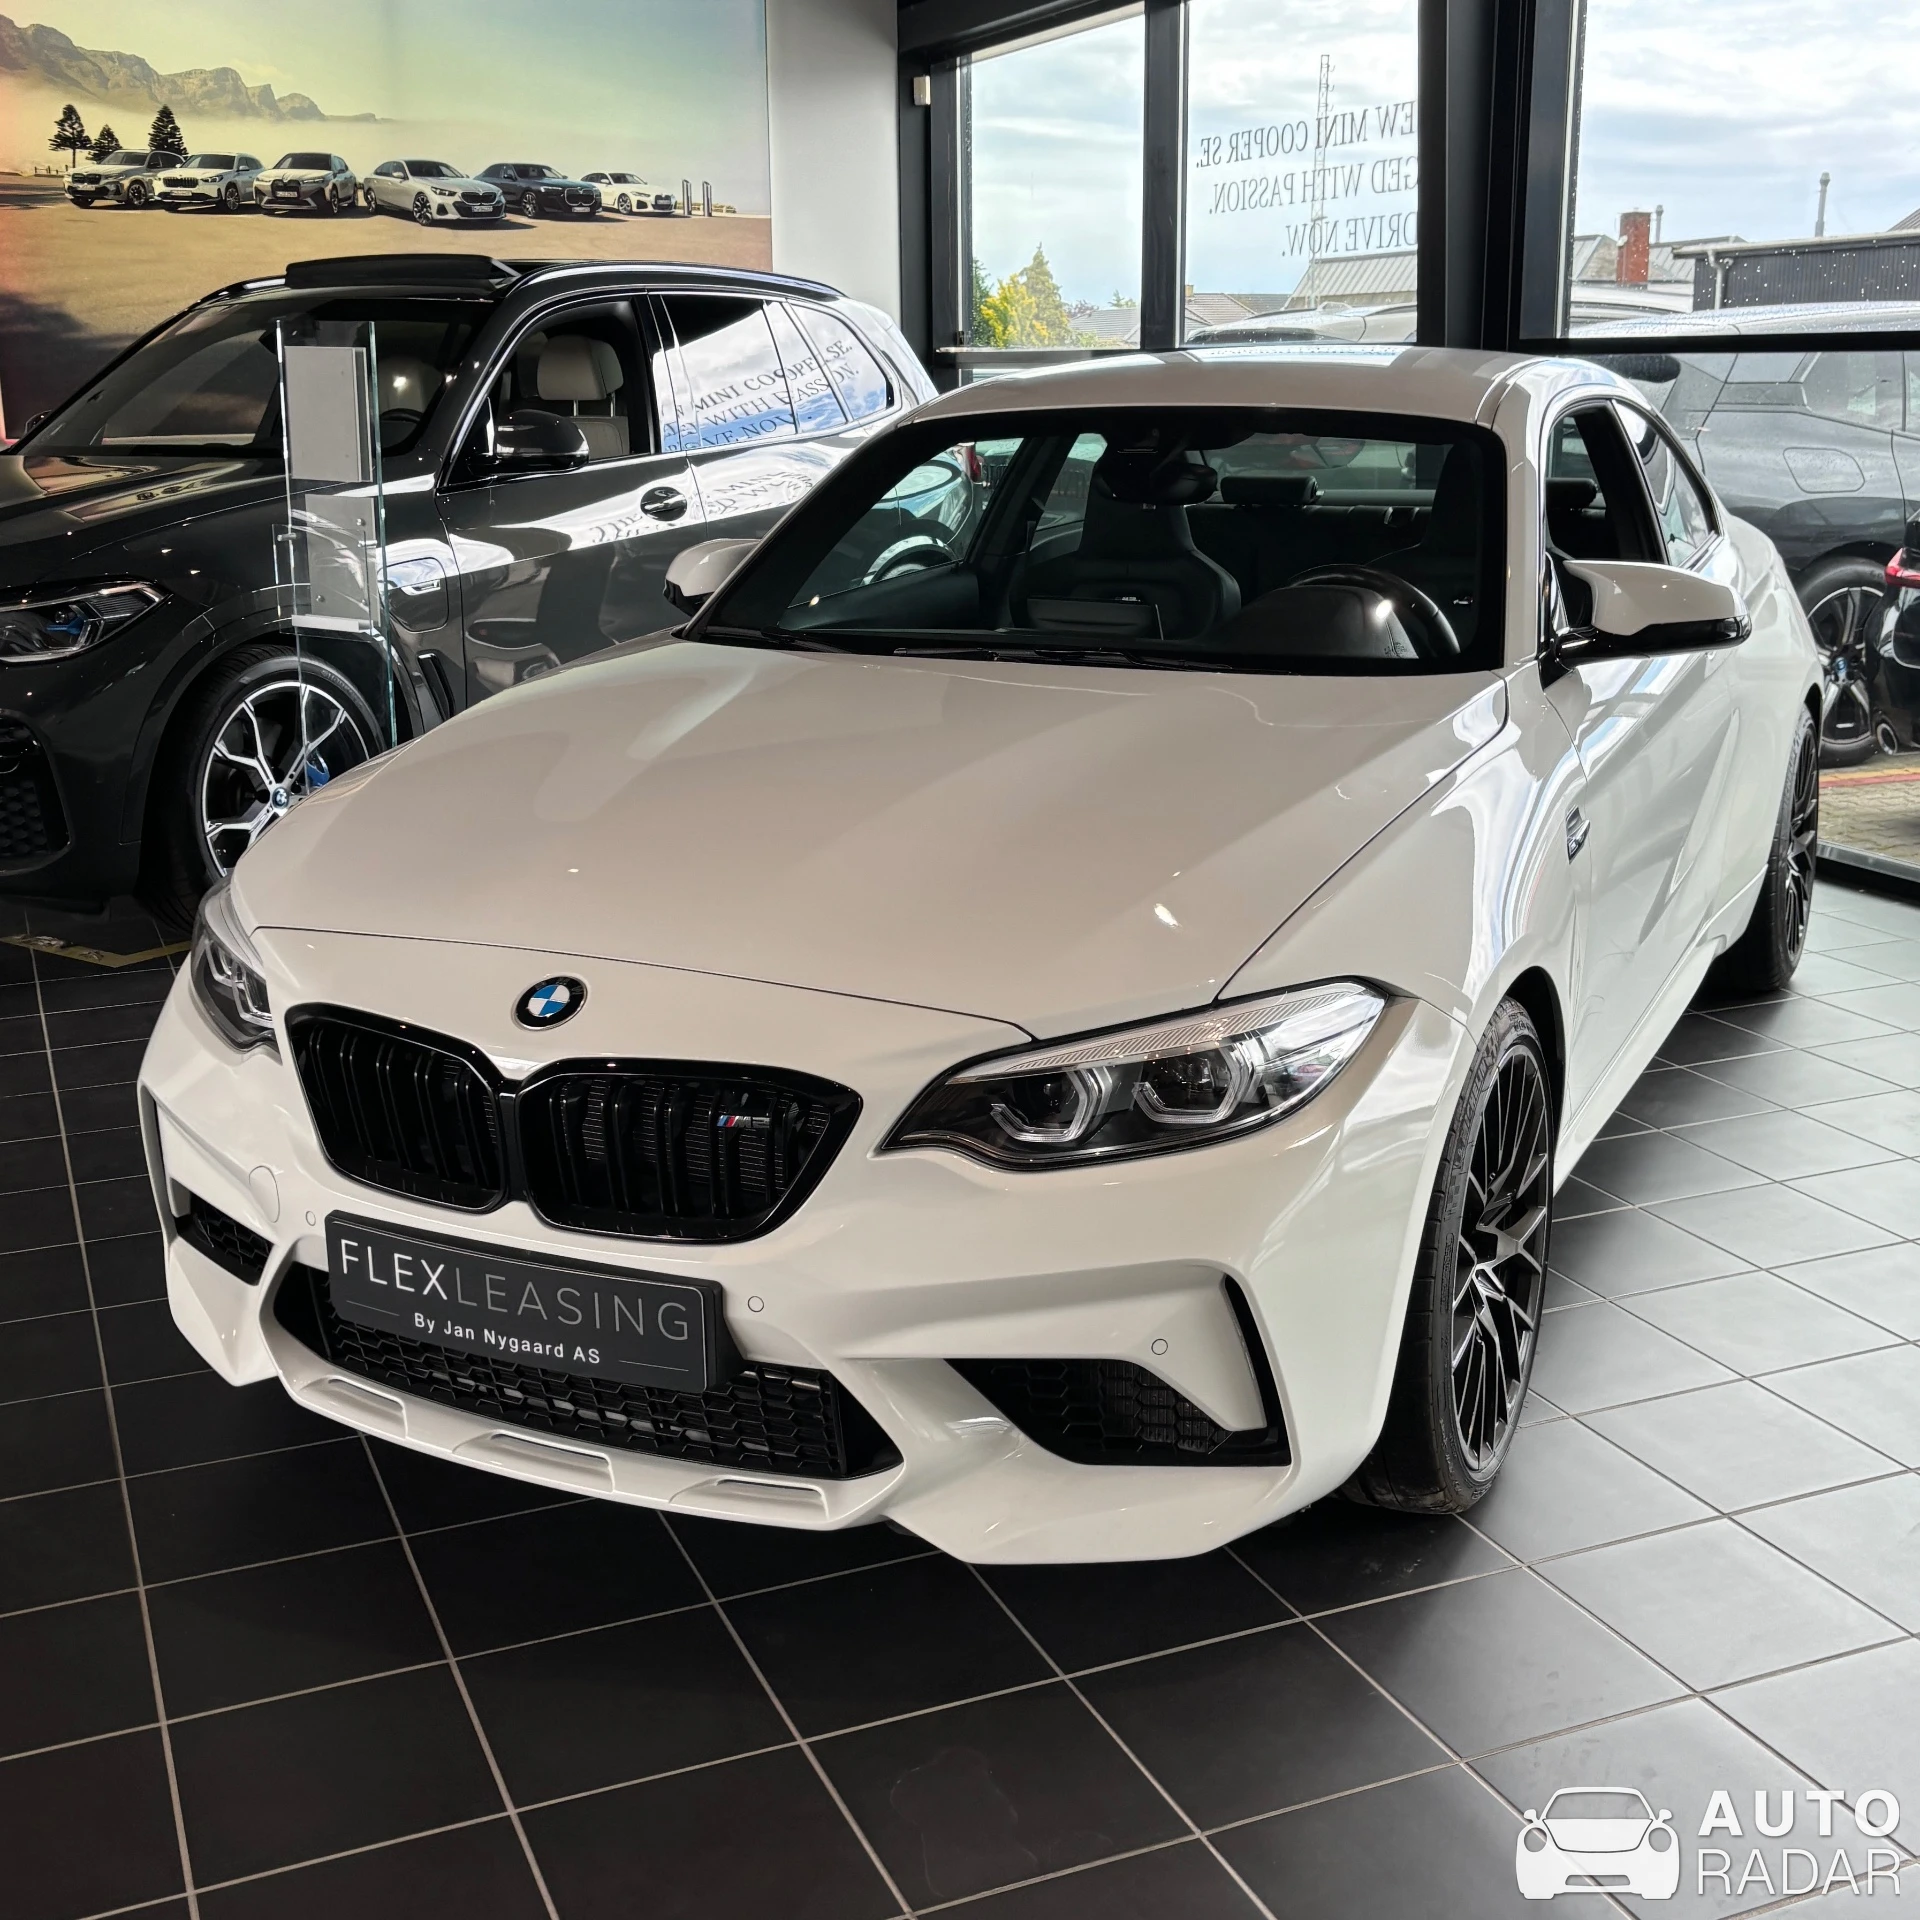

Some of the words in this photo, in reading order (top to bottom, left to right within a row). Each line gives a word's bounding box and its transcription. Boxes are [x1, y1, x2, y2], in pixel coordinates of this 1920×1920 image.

[705, 397, 773, 427] WITH
[340, 1238, 689, 1341] FLEXLEASING
[414, 1312, 435, 1334] By
[443, 1320, 475, 1341] Jan
[484, 1328, 564, 1358] Nygaard
[572, 1348, 600, 1365] AS
